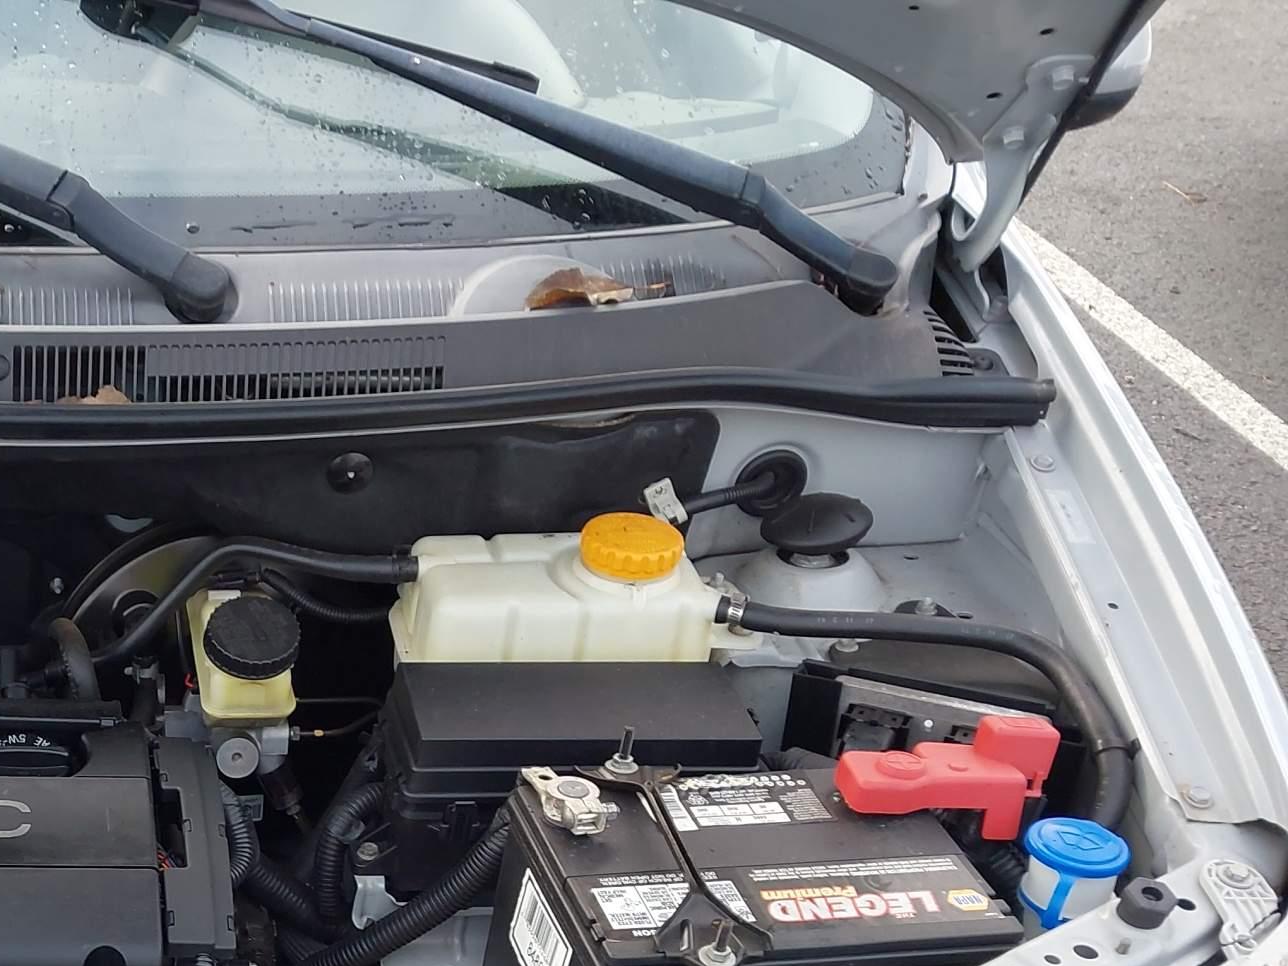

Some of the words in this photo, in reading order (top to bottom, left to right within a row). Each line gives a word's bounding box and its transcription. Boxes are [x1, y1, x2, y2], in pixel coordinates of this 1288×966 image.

[760, 885, 857, 901] Premium
[953, 895, 983, 905] NAPA
[768, 890, 941, 922] LEGEND
